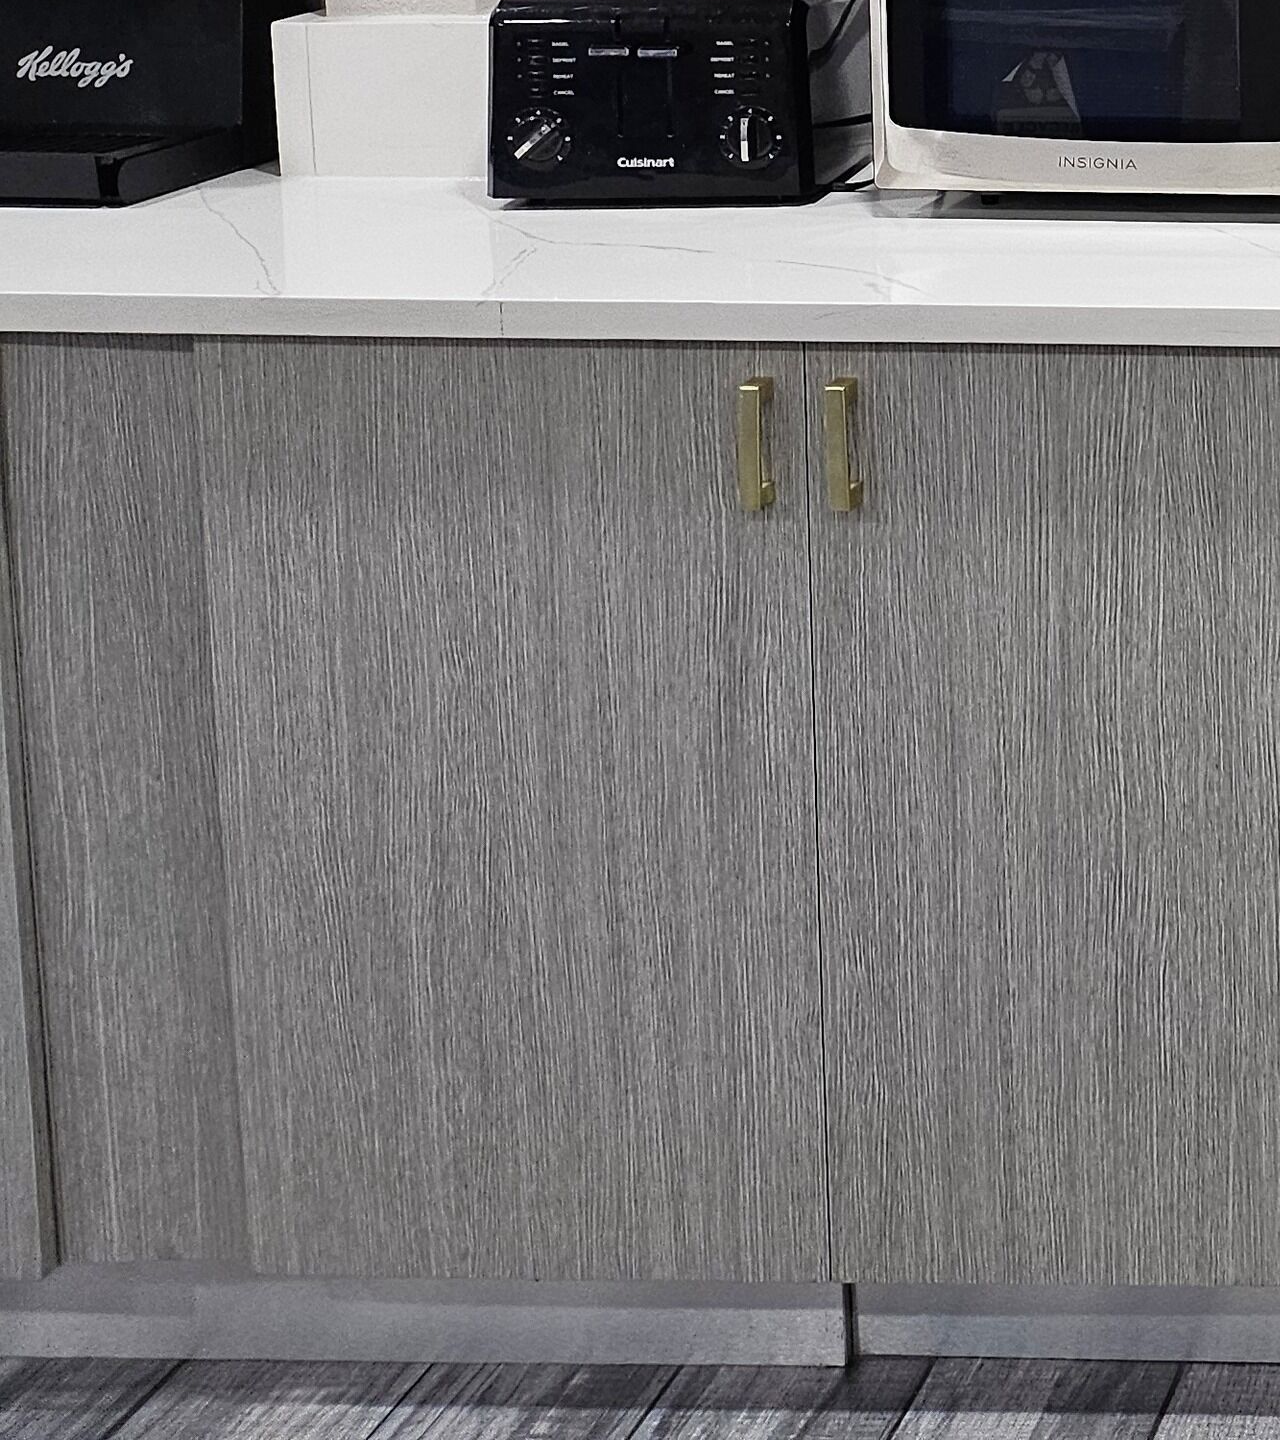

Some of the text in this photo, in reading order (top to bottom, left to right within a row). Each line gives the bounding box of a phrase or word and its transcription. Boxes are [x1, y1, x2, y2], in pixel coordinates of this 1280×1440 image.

[16, 45, 134, 88] Kellogg's
[616, 157, 675, 168] Cuisinart
[1058, 156, 1138, 170] INSIGNIA
